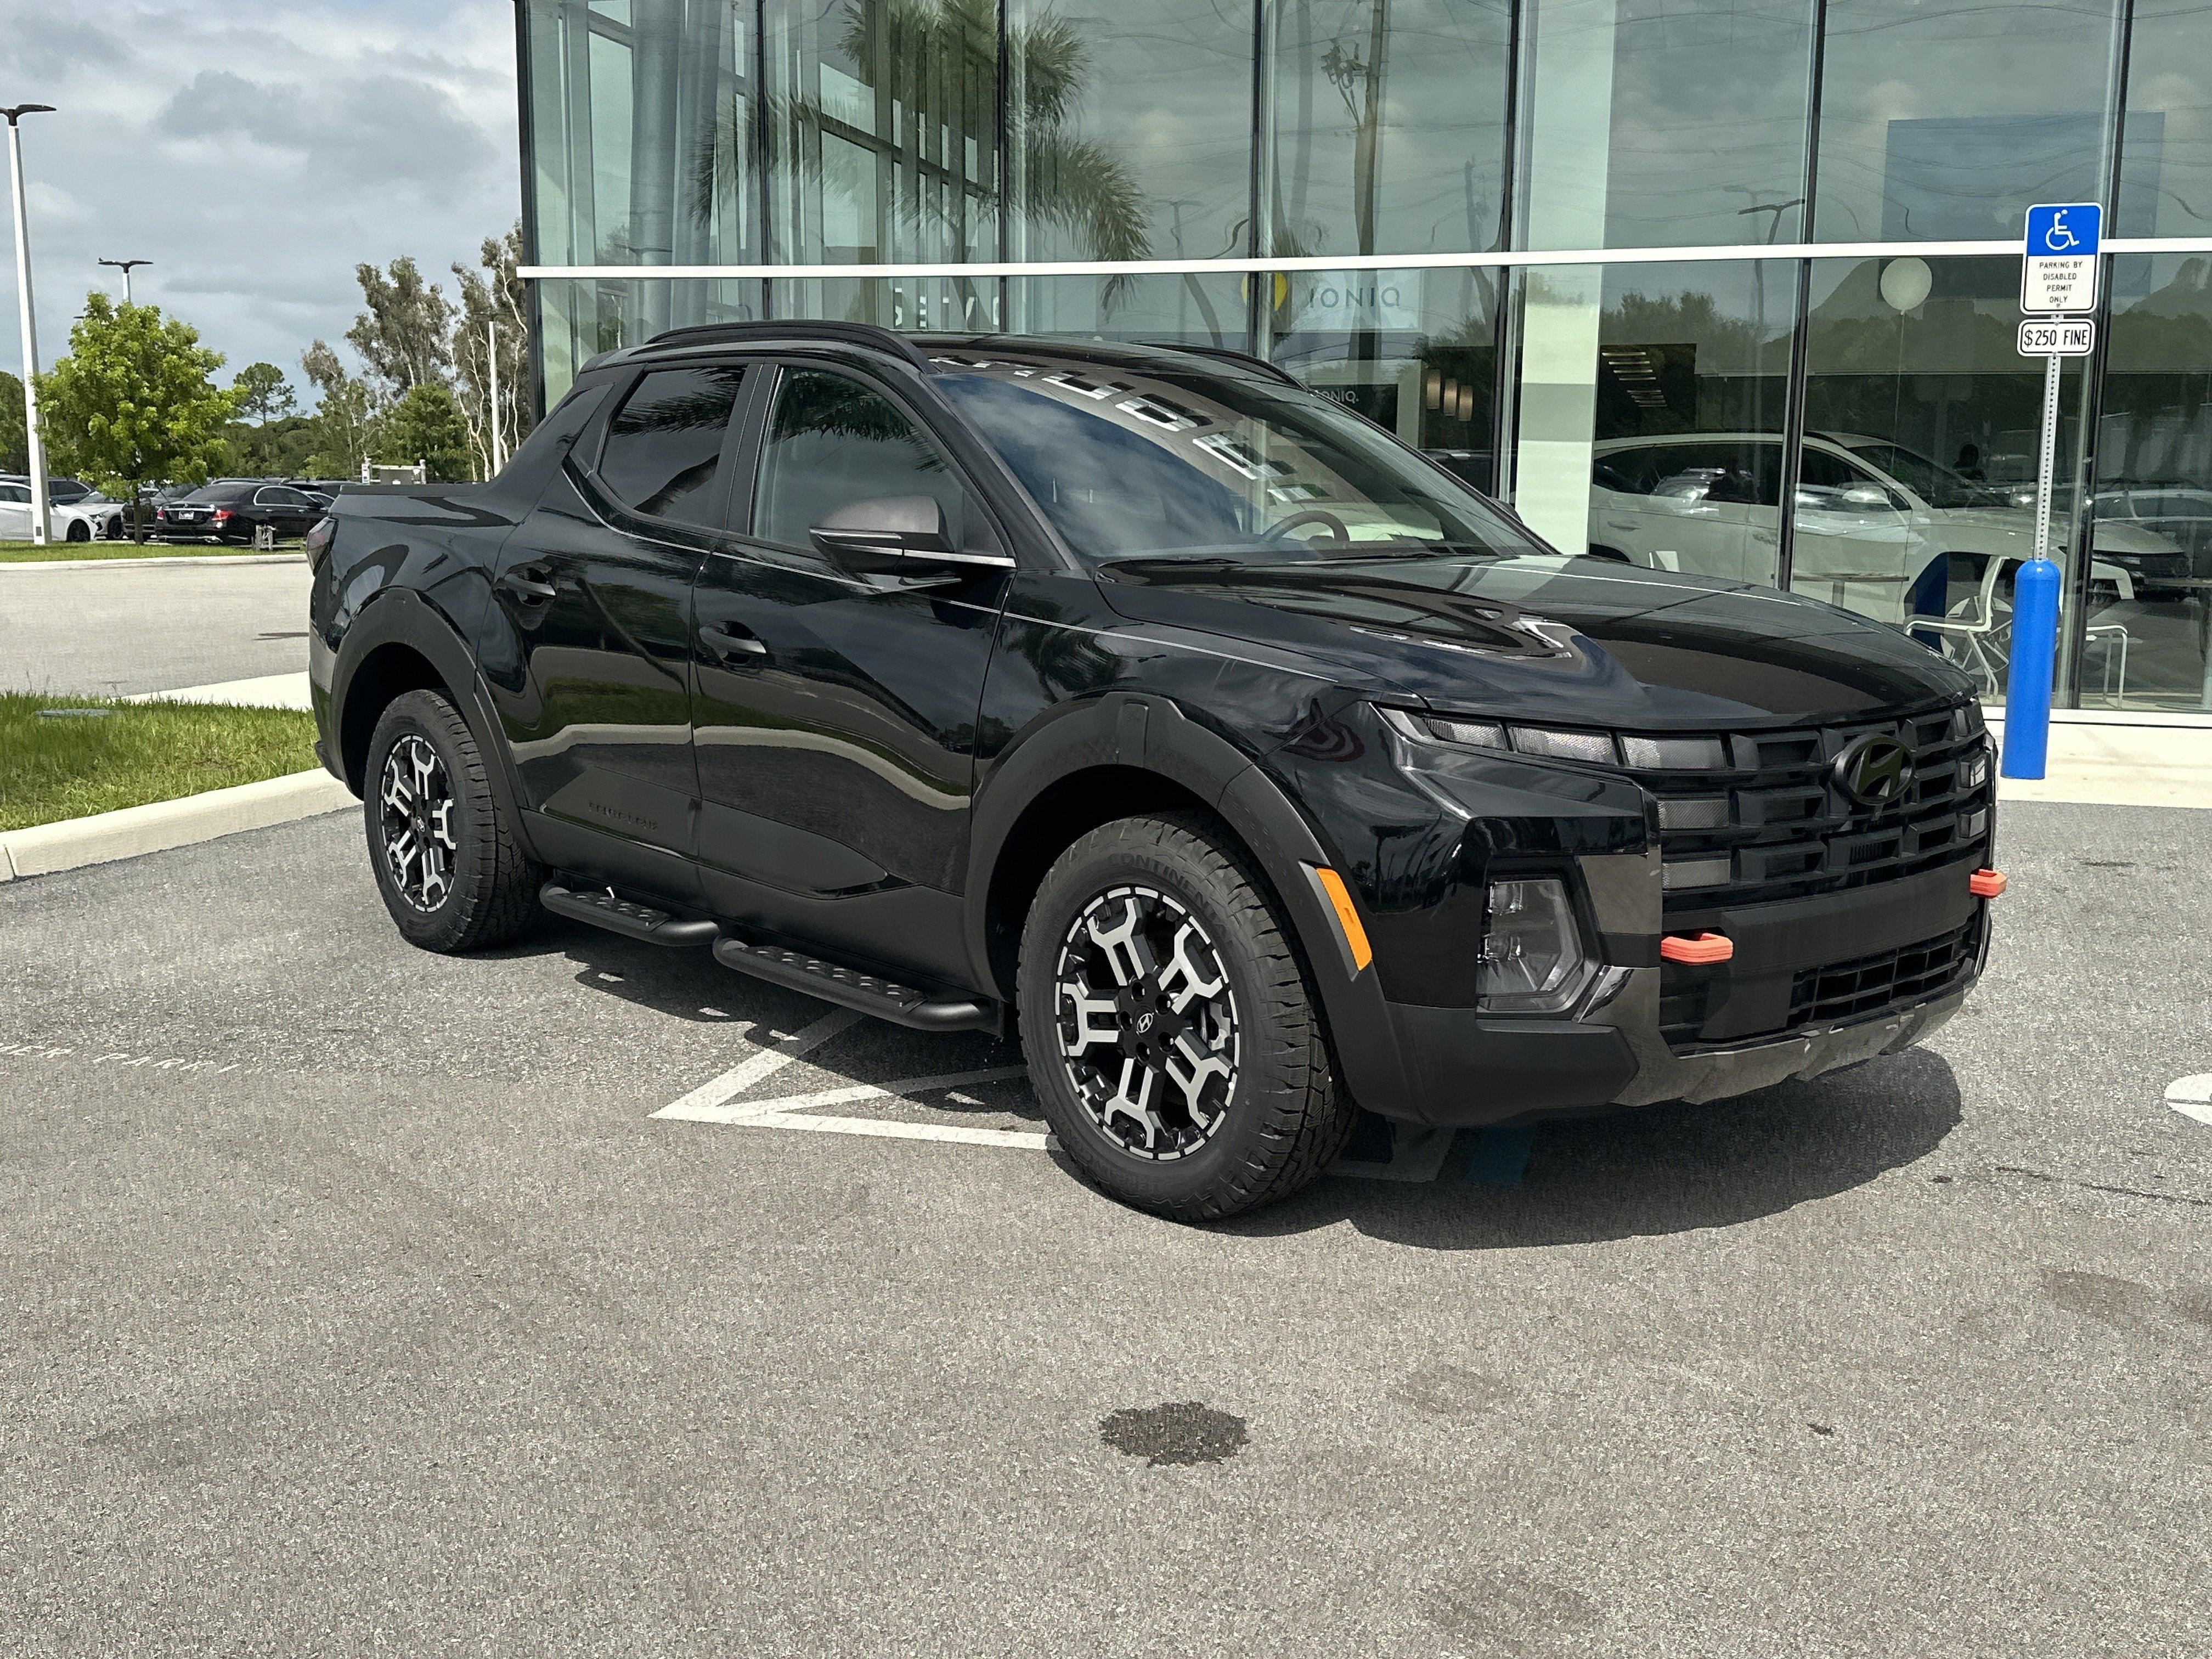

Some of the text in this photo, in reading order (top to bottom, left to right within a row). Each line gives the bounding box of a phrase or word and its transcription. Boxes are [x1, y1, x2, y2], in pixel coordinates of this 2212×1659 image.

[1310, 287, 1400, 308] IONIQ
[2024, 329, 2088, 348] $250 FINE
